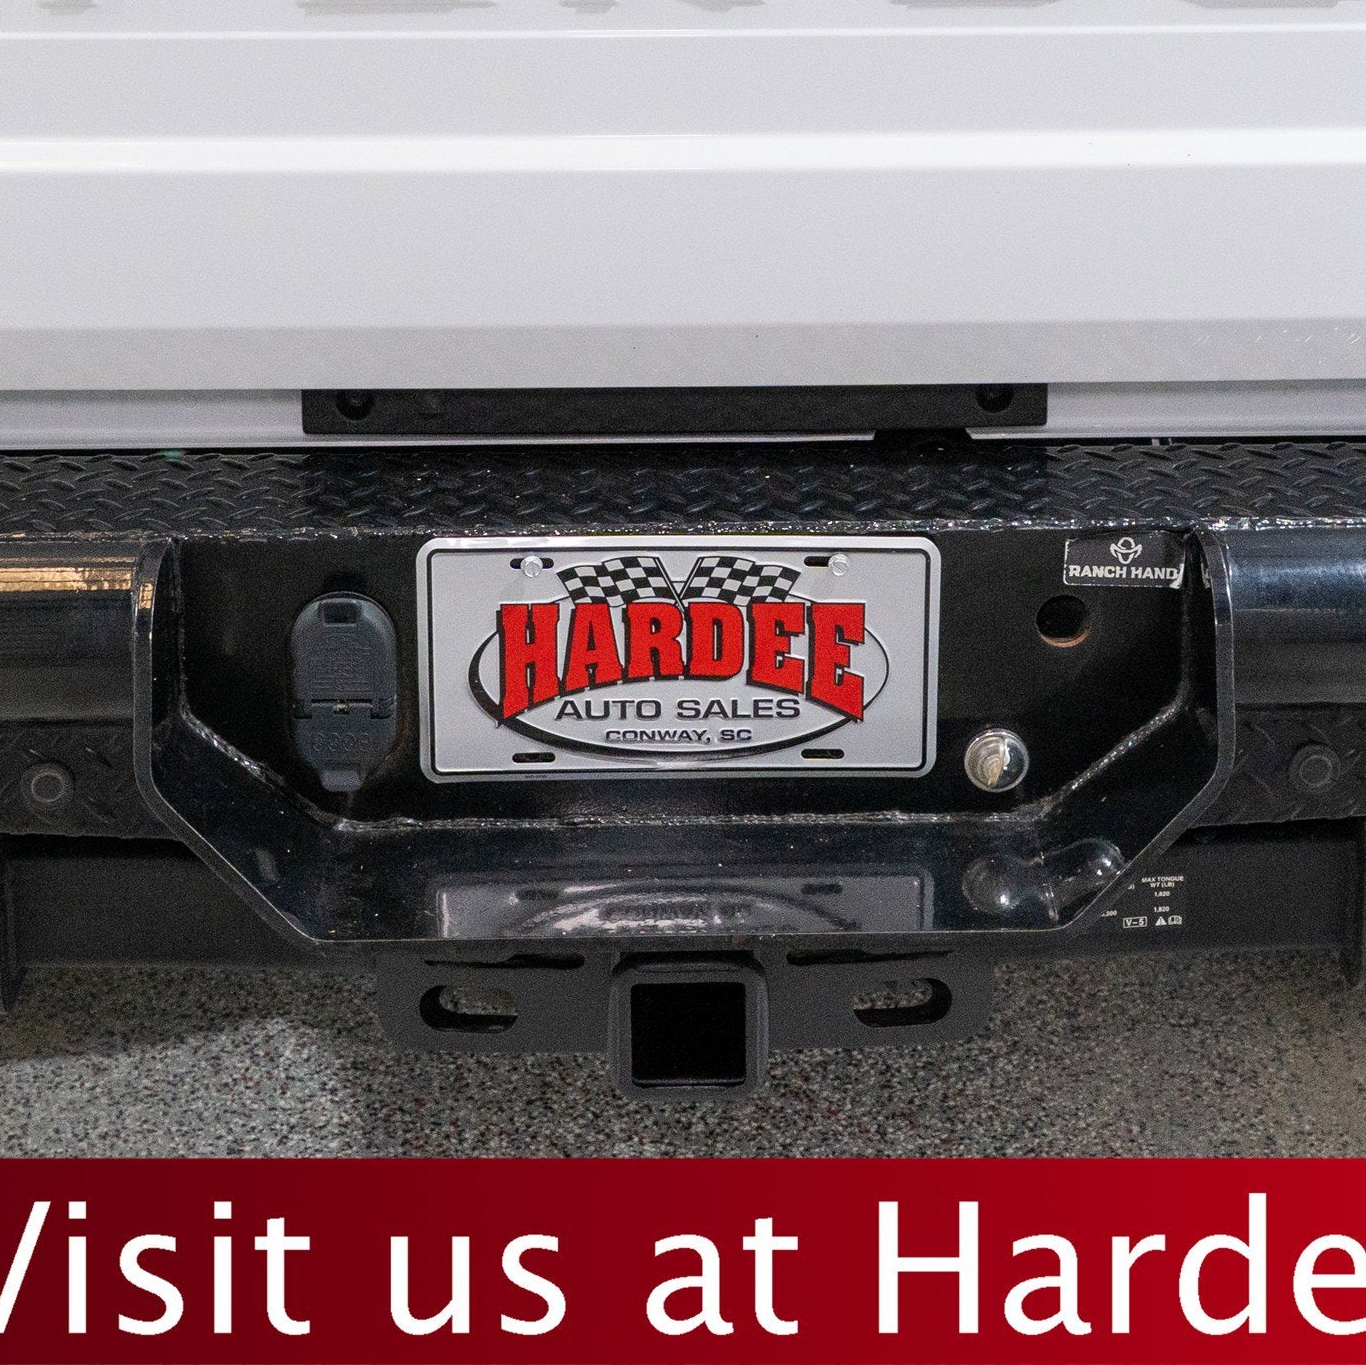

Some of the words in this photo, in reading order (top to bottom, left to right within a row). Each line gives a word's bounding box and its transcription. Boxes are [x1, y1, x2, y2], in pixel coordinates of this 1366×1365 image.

[1068, 564, 1127, 579] RANCH
[1130, 566, 1179, 580] HAND
[497, 602, 866, 727] HARDEE
[555, 699, 662, 721] AUTO
[677, 697, 802, 720] SALES
[605, 729, 712, 746] CONWAY,
[720, 729, 753, 743] SC
